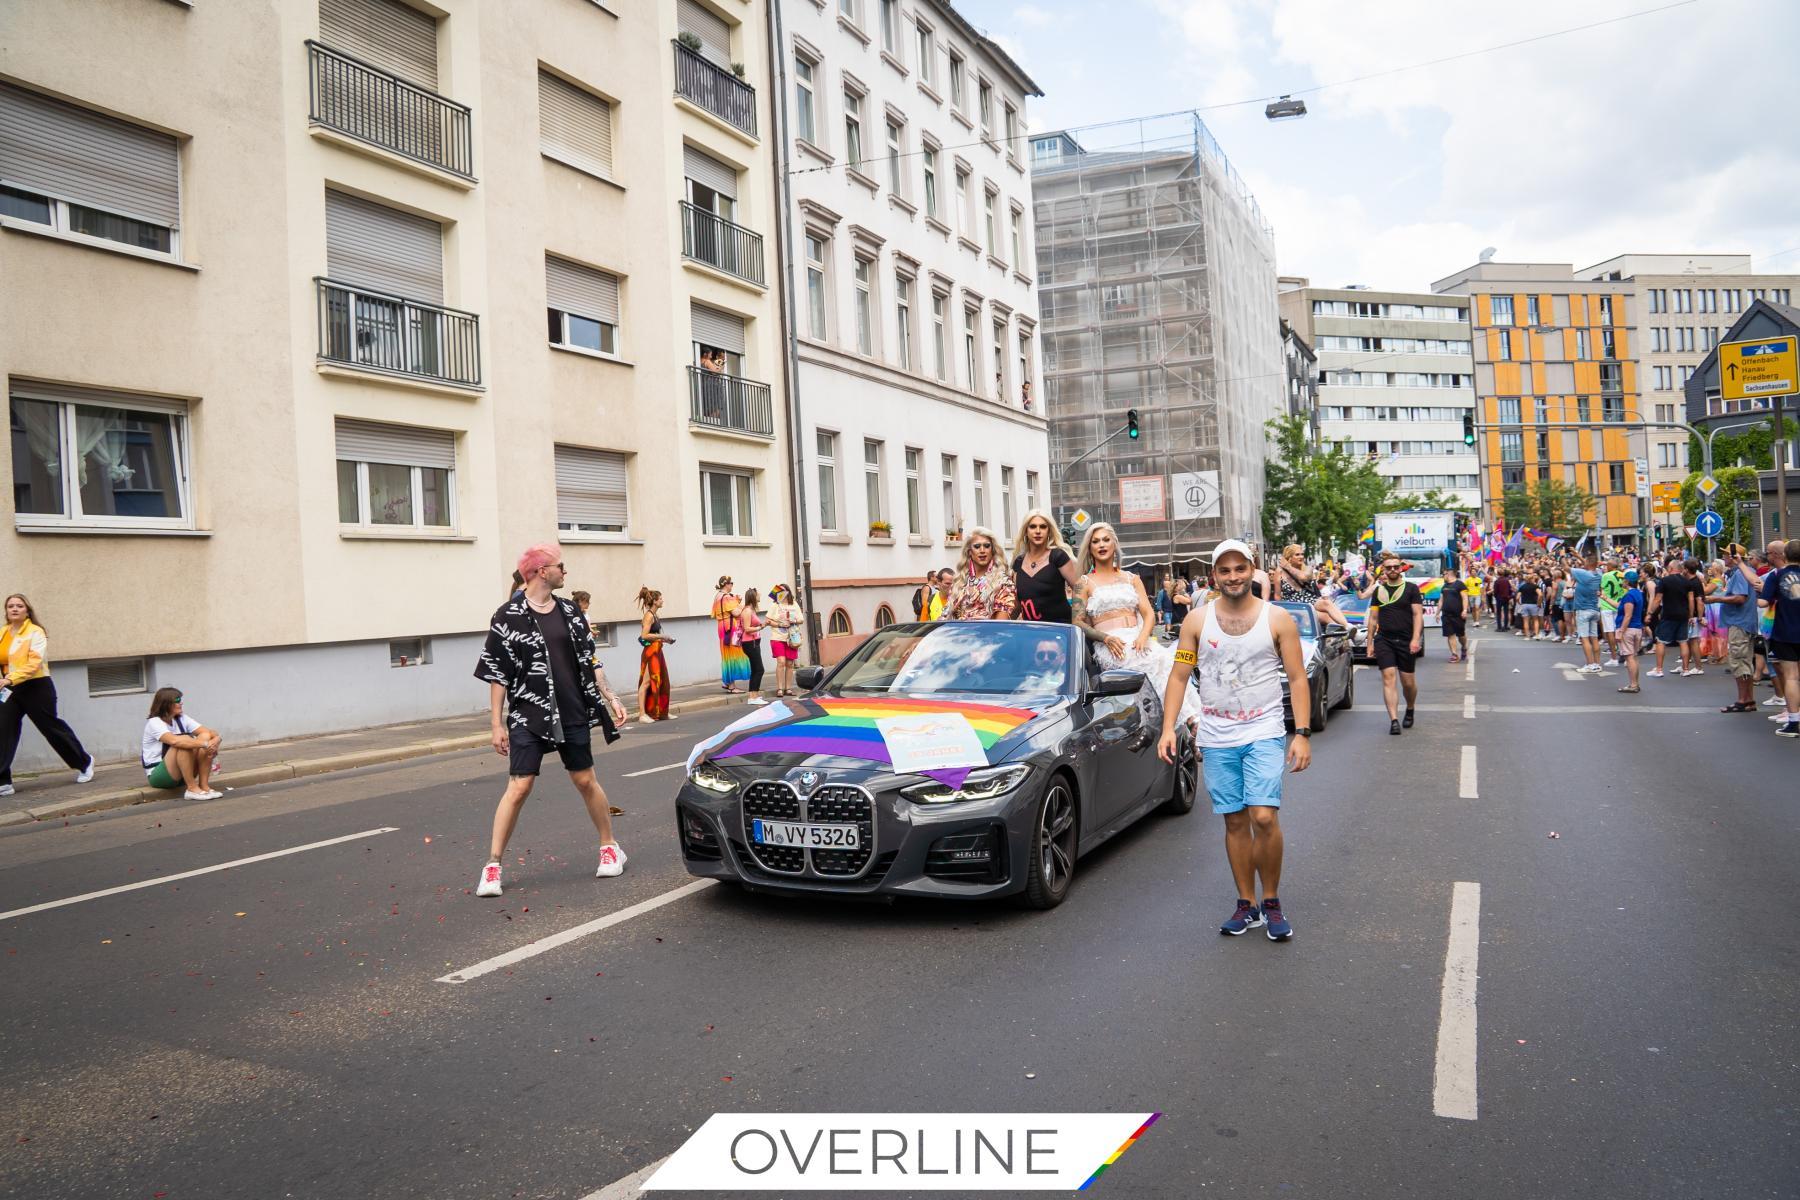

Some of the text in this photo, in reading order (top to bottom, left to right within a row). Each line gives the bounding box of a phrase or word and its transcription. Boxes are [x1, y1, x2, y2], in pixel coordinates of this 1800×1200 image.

[1742, 356, 1779, 366] Offenbach
[1742, 366, 1765, 374] Hanau
[1742, 373, 1779, 382] Friedberg
[1745, 382, 1788, 392] Sachsenhausen
[1394, 536, 1436, 546] vielbunt
[763, 824, 857, 846] M VY 5326
